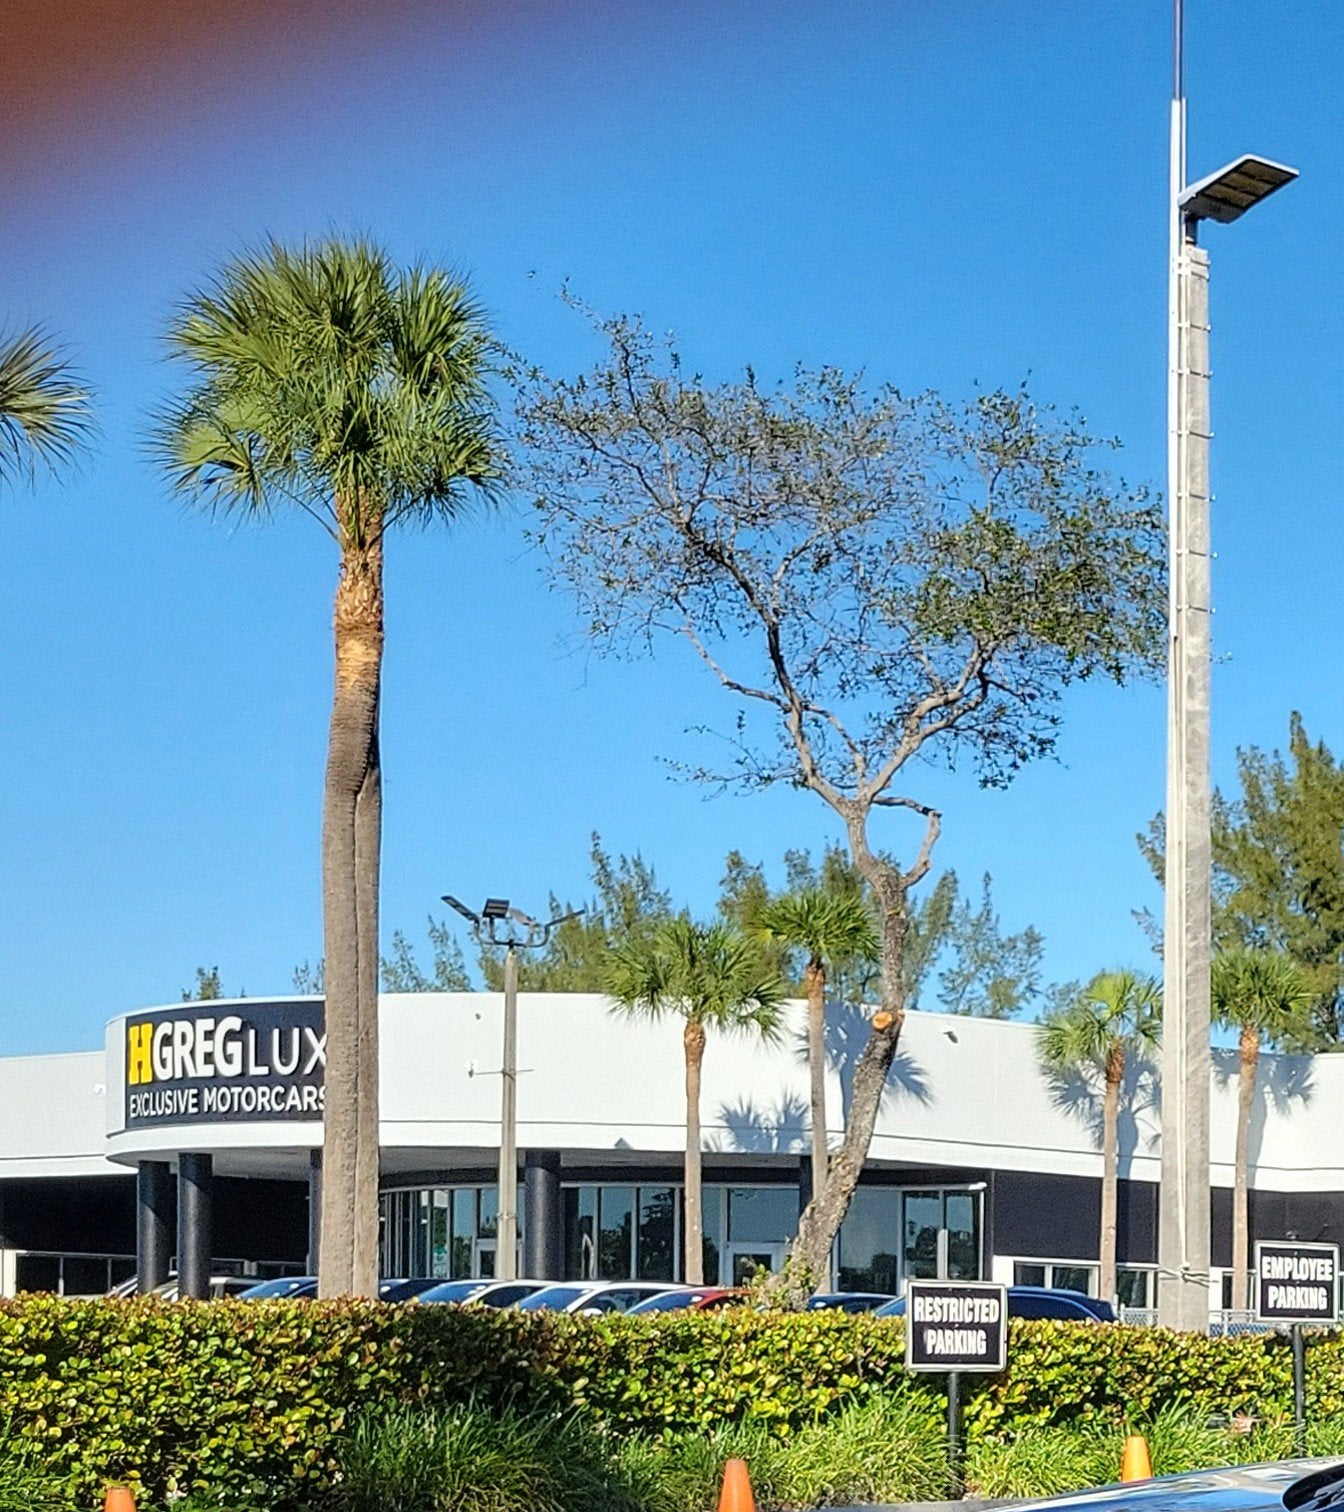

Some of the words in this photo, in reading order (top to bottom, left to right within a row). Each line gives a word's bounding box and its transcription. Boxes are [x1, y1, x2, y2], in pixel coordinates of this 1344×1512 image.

[249, 1027, 327, 1076] LUX
[130, 1087, 199, 1118] EXCLUSIVE
[1261, 1255, 1334, 1281] EMPLOYEE
[914, 1296, 1000, 1323] RESTRICTED
[1268, 1285, 1328, 1310] PARKING
[925, 1329, 987, 1355] PARKING
